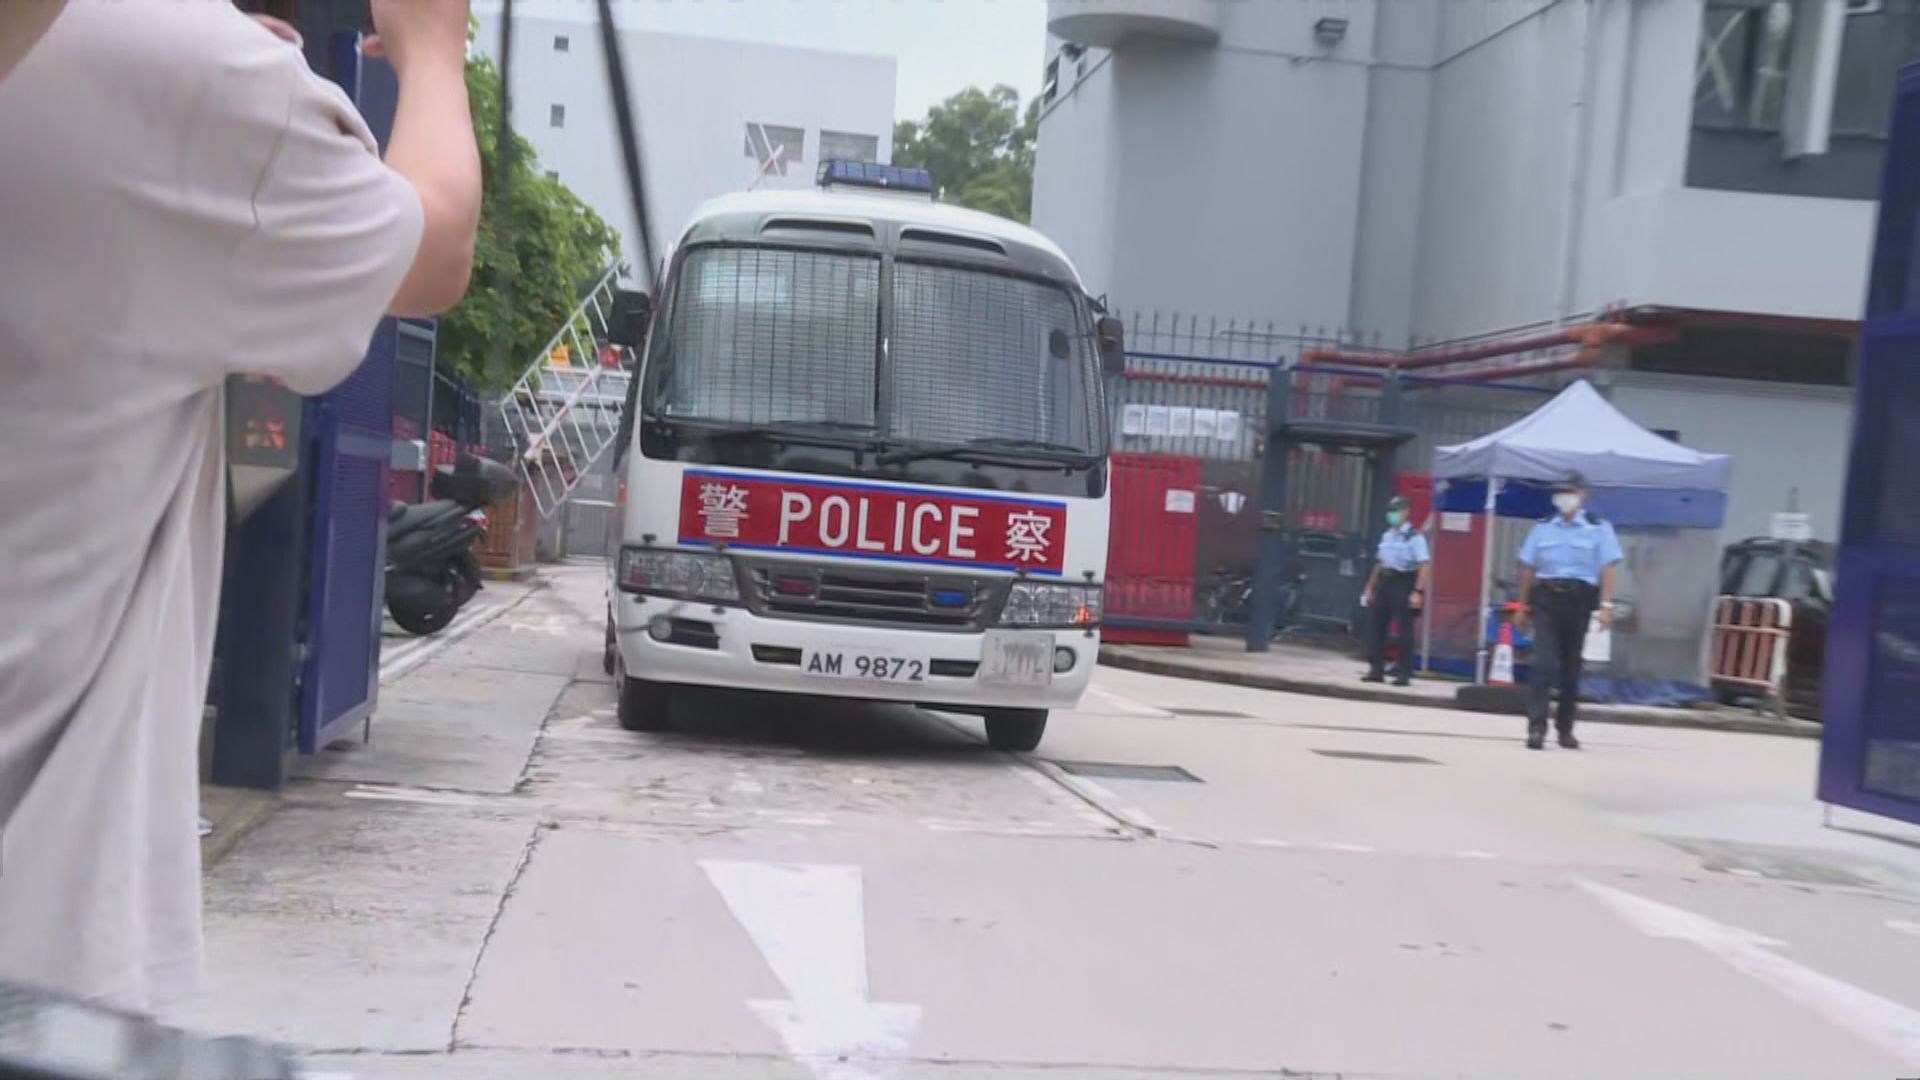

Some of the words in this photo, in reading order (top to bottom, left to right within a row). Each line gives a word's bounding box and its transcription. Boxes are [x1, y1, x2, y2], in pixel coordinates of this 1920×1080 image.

[698, 482, 749, 538] 警
[777, 488, 980, 560] POLICE
[1005, 510, 1052, 563] 察
[808, 652, 843, 675] AM
[855, 656, 923, 681] 9872
